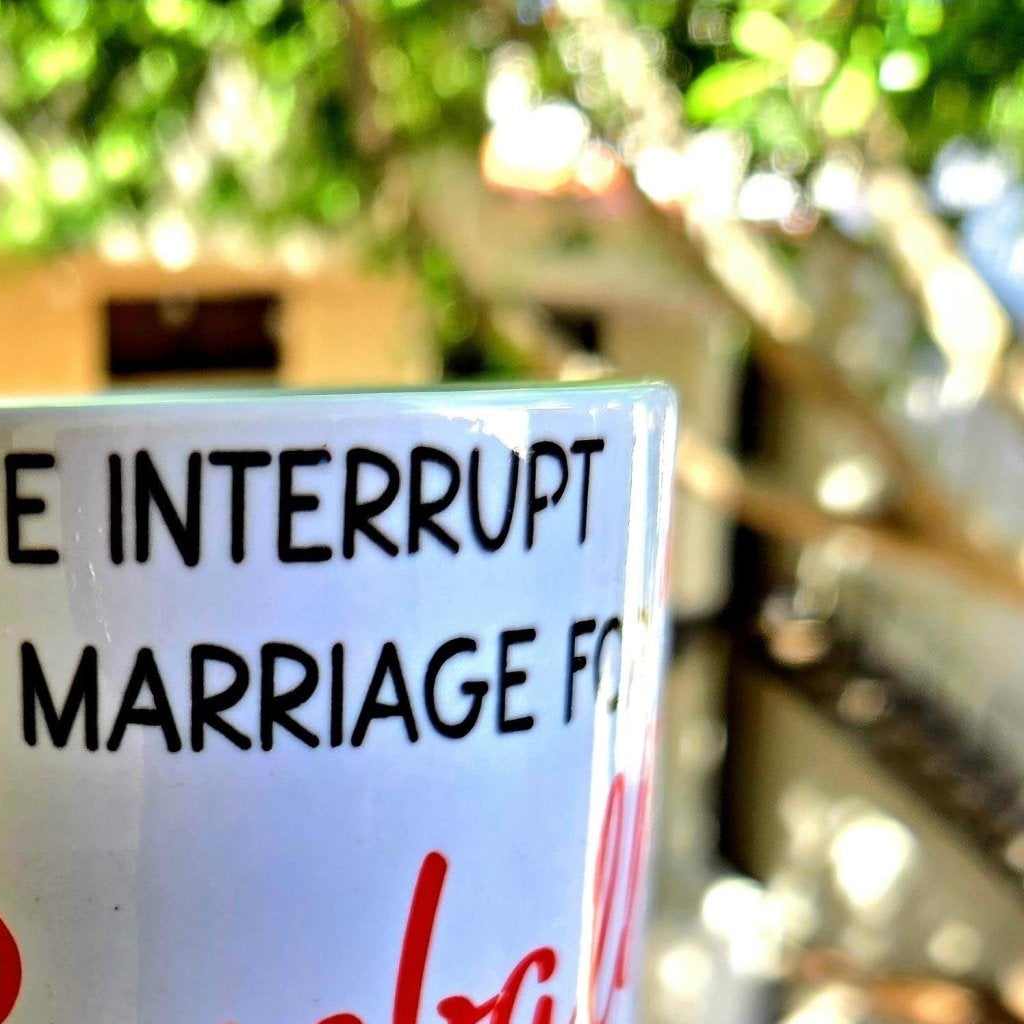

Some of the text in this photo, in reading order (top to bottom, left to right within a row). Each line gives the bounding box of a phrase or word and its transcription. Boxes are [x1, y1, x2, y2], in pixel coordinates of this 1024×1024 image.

[107, 438, 605, 568] INTERRUPT
[20, 628, 538, 753] MARRIAGE
[563, 617, 624, 724] FO
